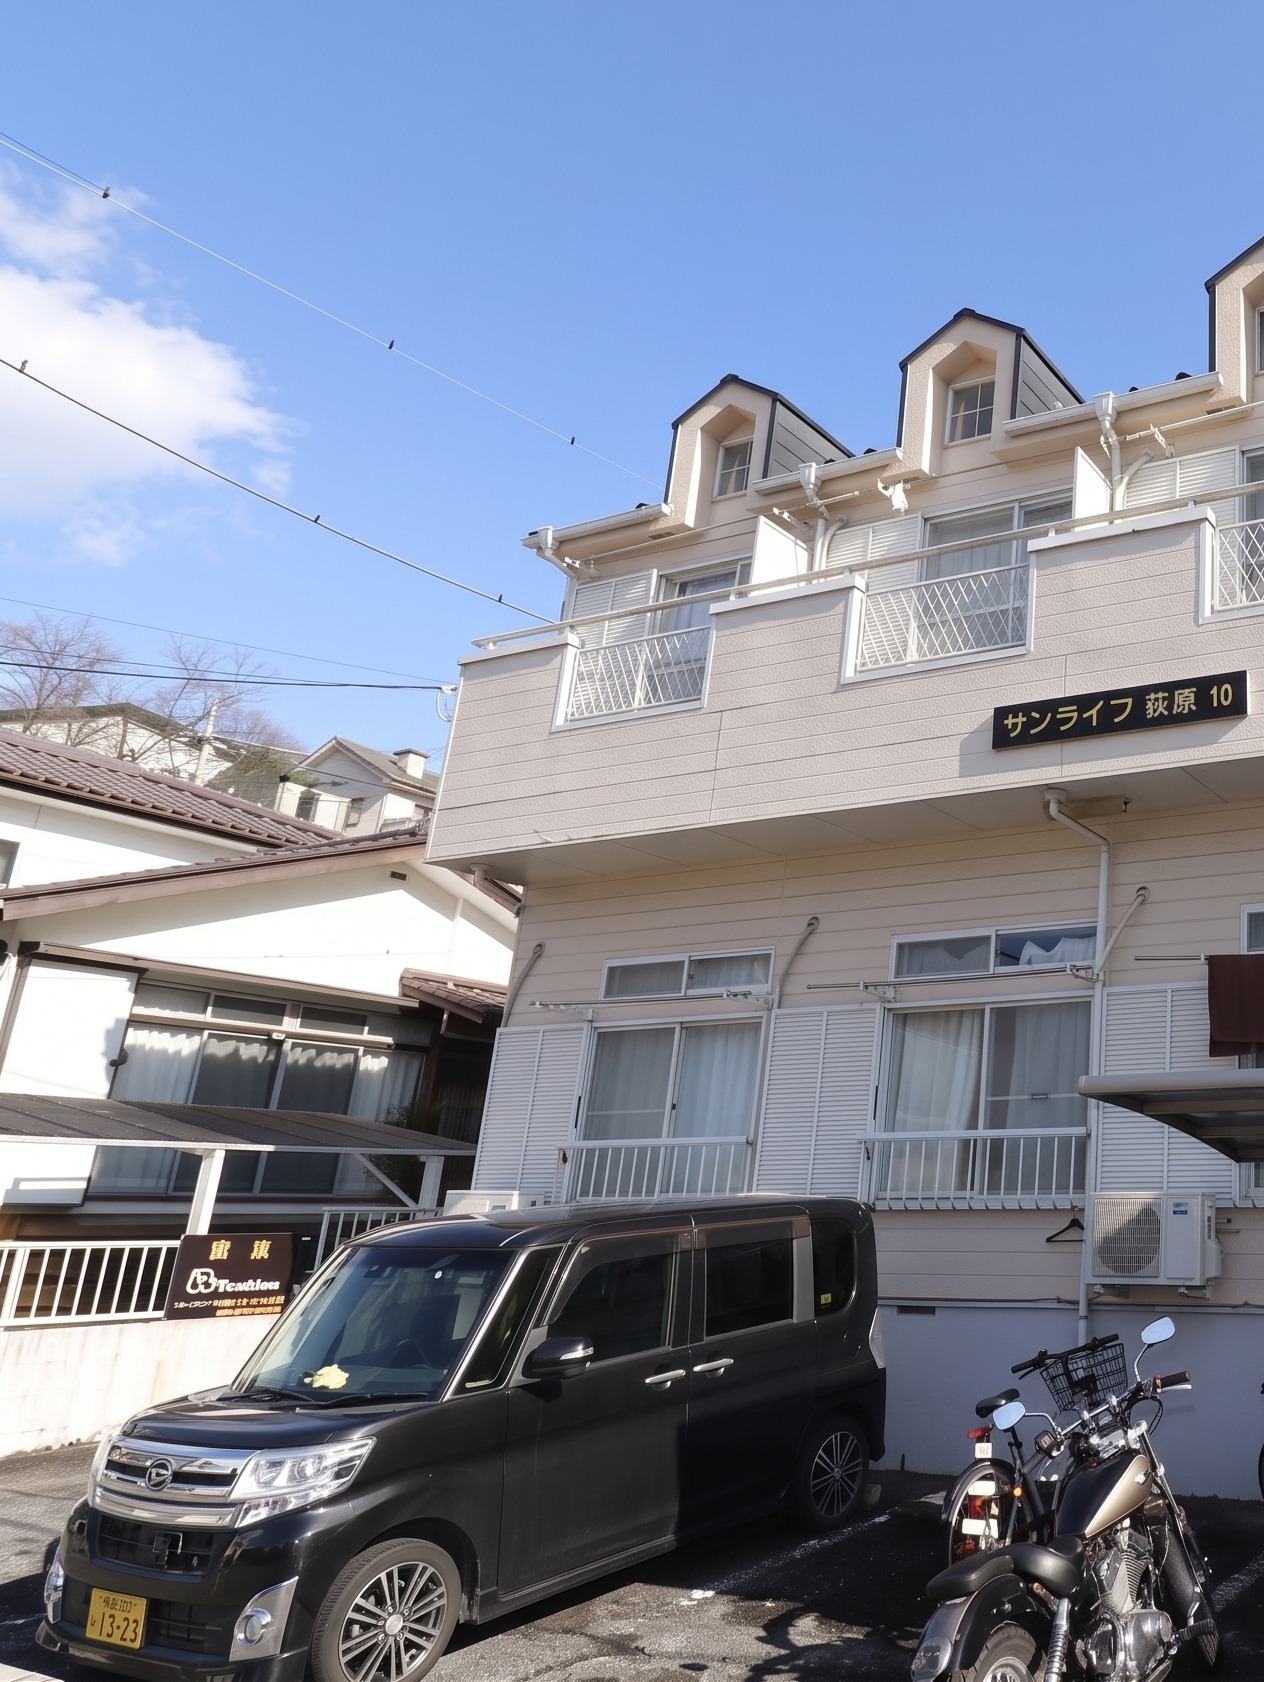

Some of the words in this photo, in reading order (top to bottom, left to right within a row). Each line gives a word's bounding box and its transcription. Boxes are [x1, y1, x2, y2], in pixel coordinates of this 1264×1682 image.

[1003, 697, 1133, 738] サンライフ
[1145, 687, 1198, 719] 荻原
[1209, 683, 1233, 708] 10
